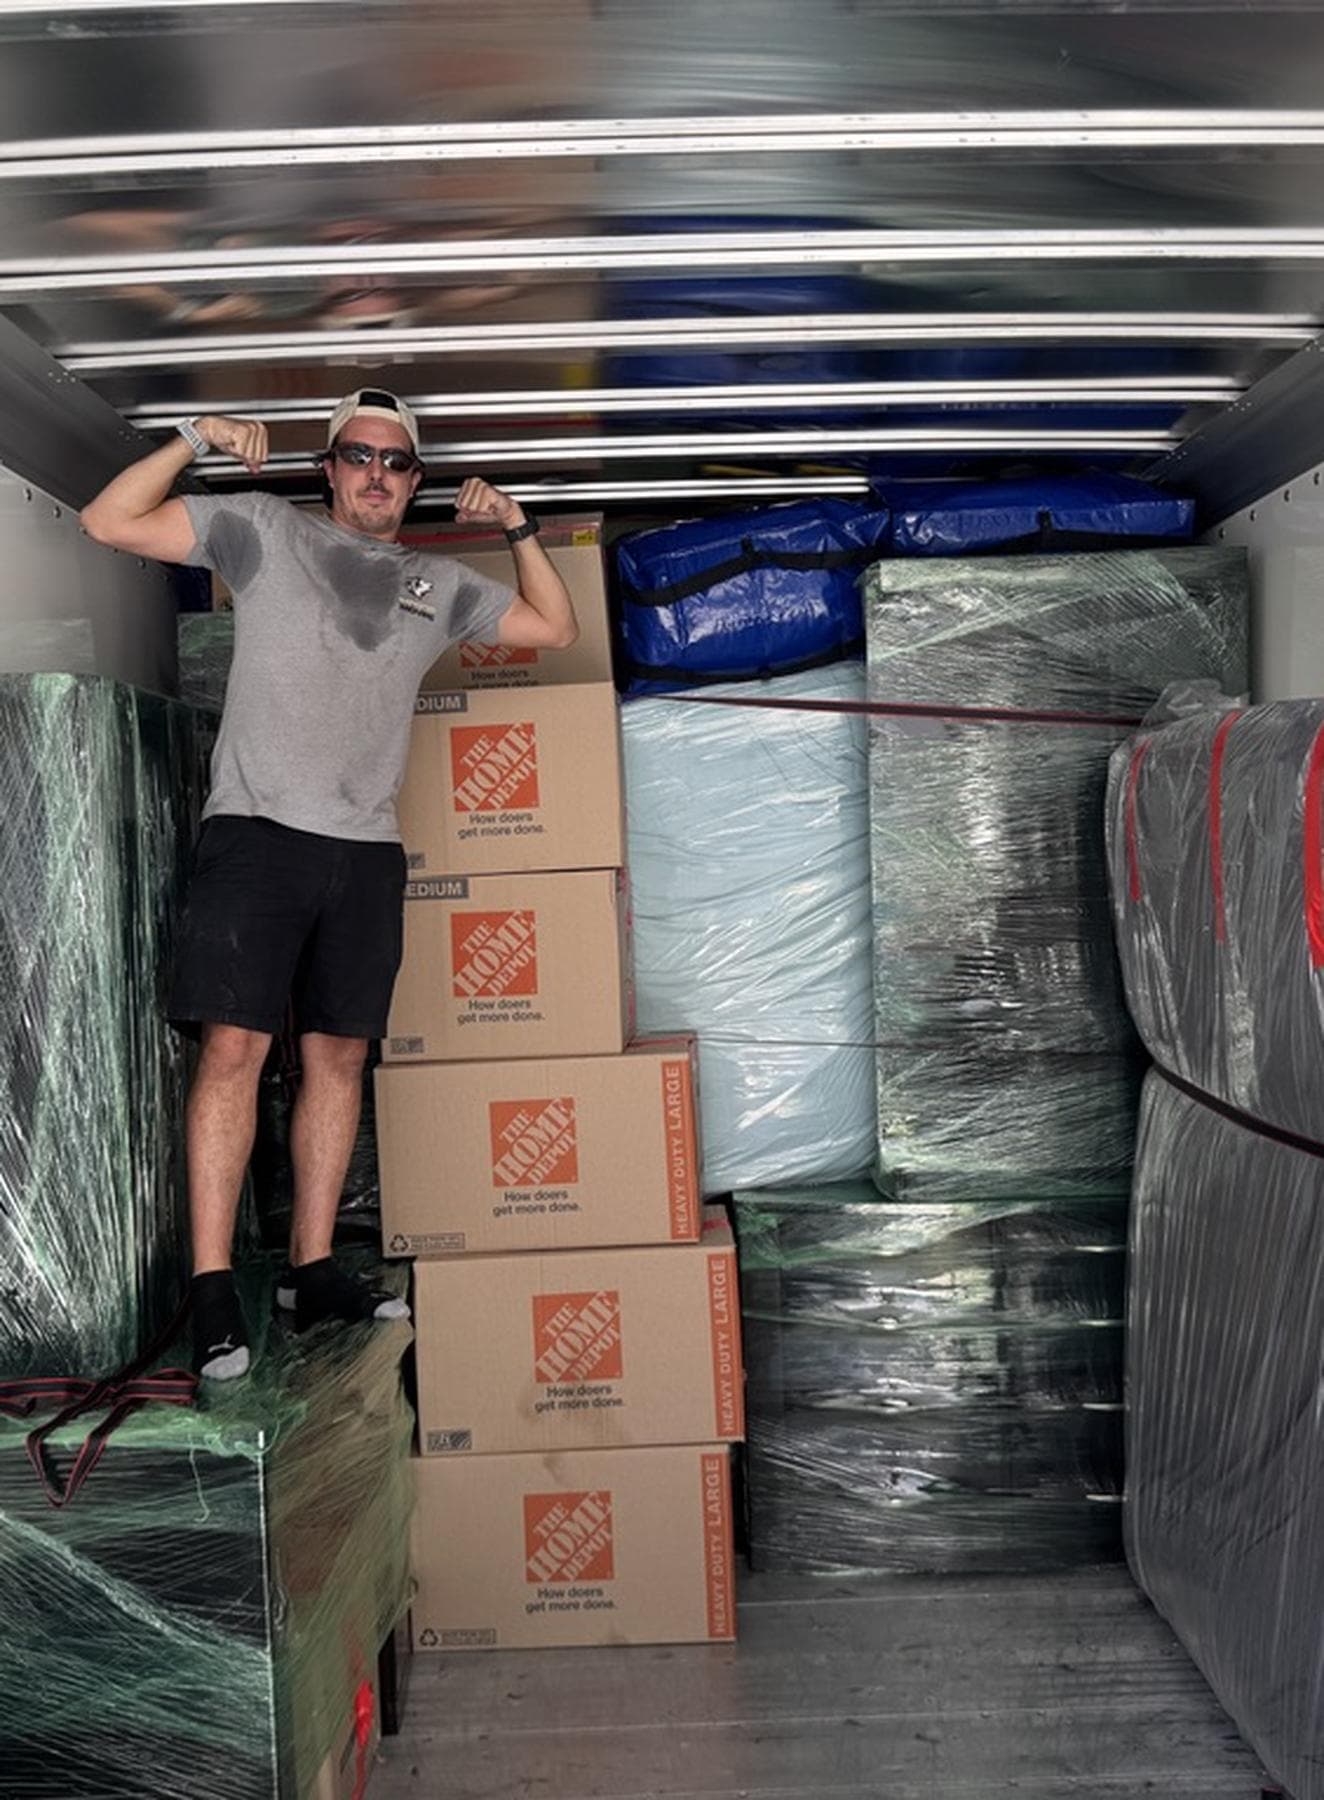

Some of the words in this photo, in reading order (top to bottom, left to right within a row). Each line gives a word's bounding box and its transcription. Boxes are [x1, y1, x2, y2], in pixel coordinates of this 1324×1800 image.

[415, 694, 462, 712] DIUM
[453, 722, 536, 811] HOME
[460, 734, 494, 769] THE
[487, 754, 540, 810] DEPOT
[457, 826, 478, 839] get
[480, 825, 512, 837] more
[468, 813, 497, 824] How
[499, 812, 533, 823] doers
[405, 882, 463, 897] EDIUM
[453, 910, 536, 997] HOME
[459, 920, 494, 955] THE
[486, 941, 537, 996] DEPOT
[457, 1013, 477, 1026] get
[478, 1012, 510, 1023] more
[511, 1010, 546, 1022] done.
[468, 999, 496, 1011] How
[498, 998, 531, 1010] doers
[665, 1065, 683, 1131] LARGE
[493, 1098, 575, 1187] HOME
[499, 1109, 534, 1145] THE
[526, 1128, 577, 1186] DEPOT
[671, 1137, 685, 1178] DUTY
[492, 1205, 513, 1218] get
[514, 1203, 548, 1214] more
[504, 1191, 532, 1203] How
[534, 1189, 569, 1201] doers
[674, 1182, 689, 1235] HEAVY
[711, 1258, 730, 1324] LARGE
[536, 1290, 620, 1382] HOME
[542, 1301, 577, 1338] THE
[569, 1323, 621, 1380] DEPOT
[717, 1330, 732, 1374] DUTY
[534, 1400, 556, 1413] get
[558, 1398, 590, 1410] more
[546, 1386, 575, 1397] How
[577, 1384, 613, 1396] doers
[720, 1378, 735, 1432] HEAVY
[705, 1458, 722, 1526] LARGE
[527, 1490, 613, 1581] HOME
[532, 1501, 570, 1539] THE
[560, 1523, 613, 1581] DEPOT
[710, 1533, 725, 1577] DUTY
[525, 1601, 547, 1614] get
[548, 1600, 581, 1612] more
[537, 1587, 565, 1599] How
[567, 1586, 604, 1598] doers
[712, 1580, 727, 1634] HEAVY
